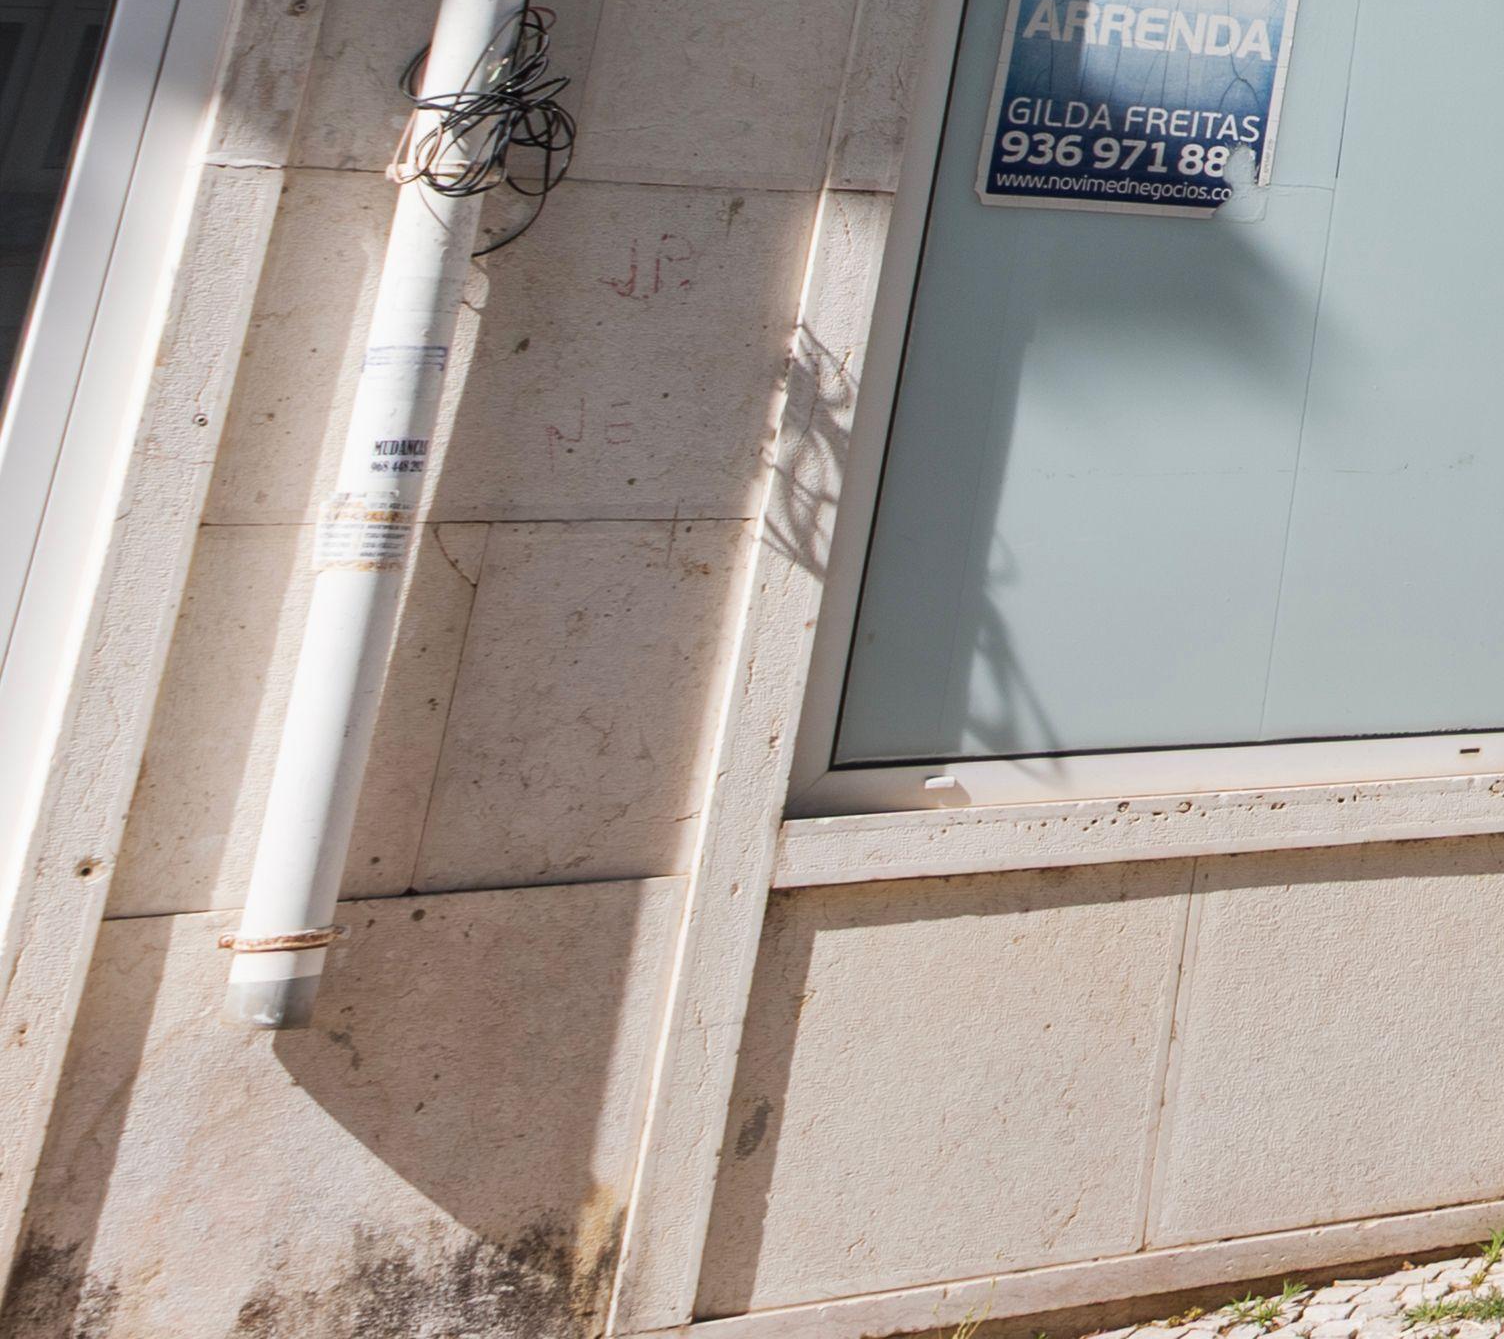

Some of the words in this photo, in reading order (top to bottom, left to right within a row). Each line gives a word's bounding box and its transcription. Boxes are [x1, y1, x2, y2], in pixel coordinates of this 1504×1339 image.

[1007, 96, 1112, 131] GILDA
[1124, 106, 1261, 143] FREITAS
[1001, 130, 1083, 167] 936
[1092, 137, 1168, 173] 971
[1177, 143, 1255, 179] 88
[996, 173, 1232, 201] www.novimednegocios.co
